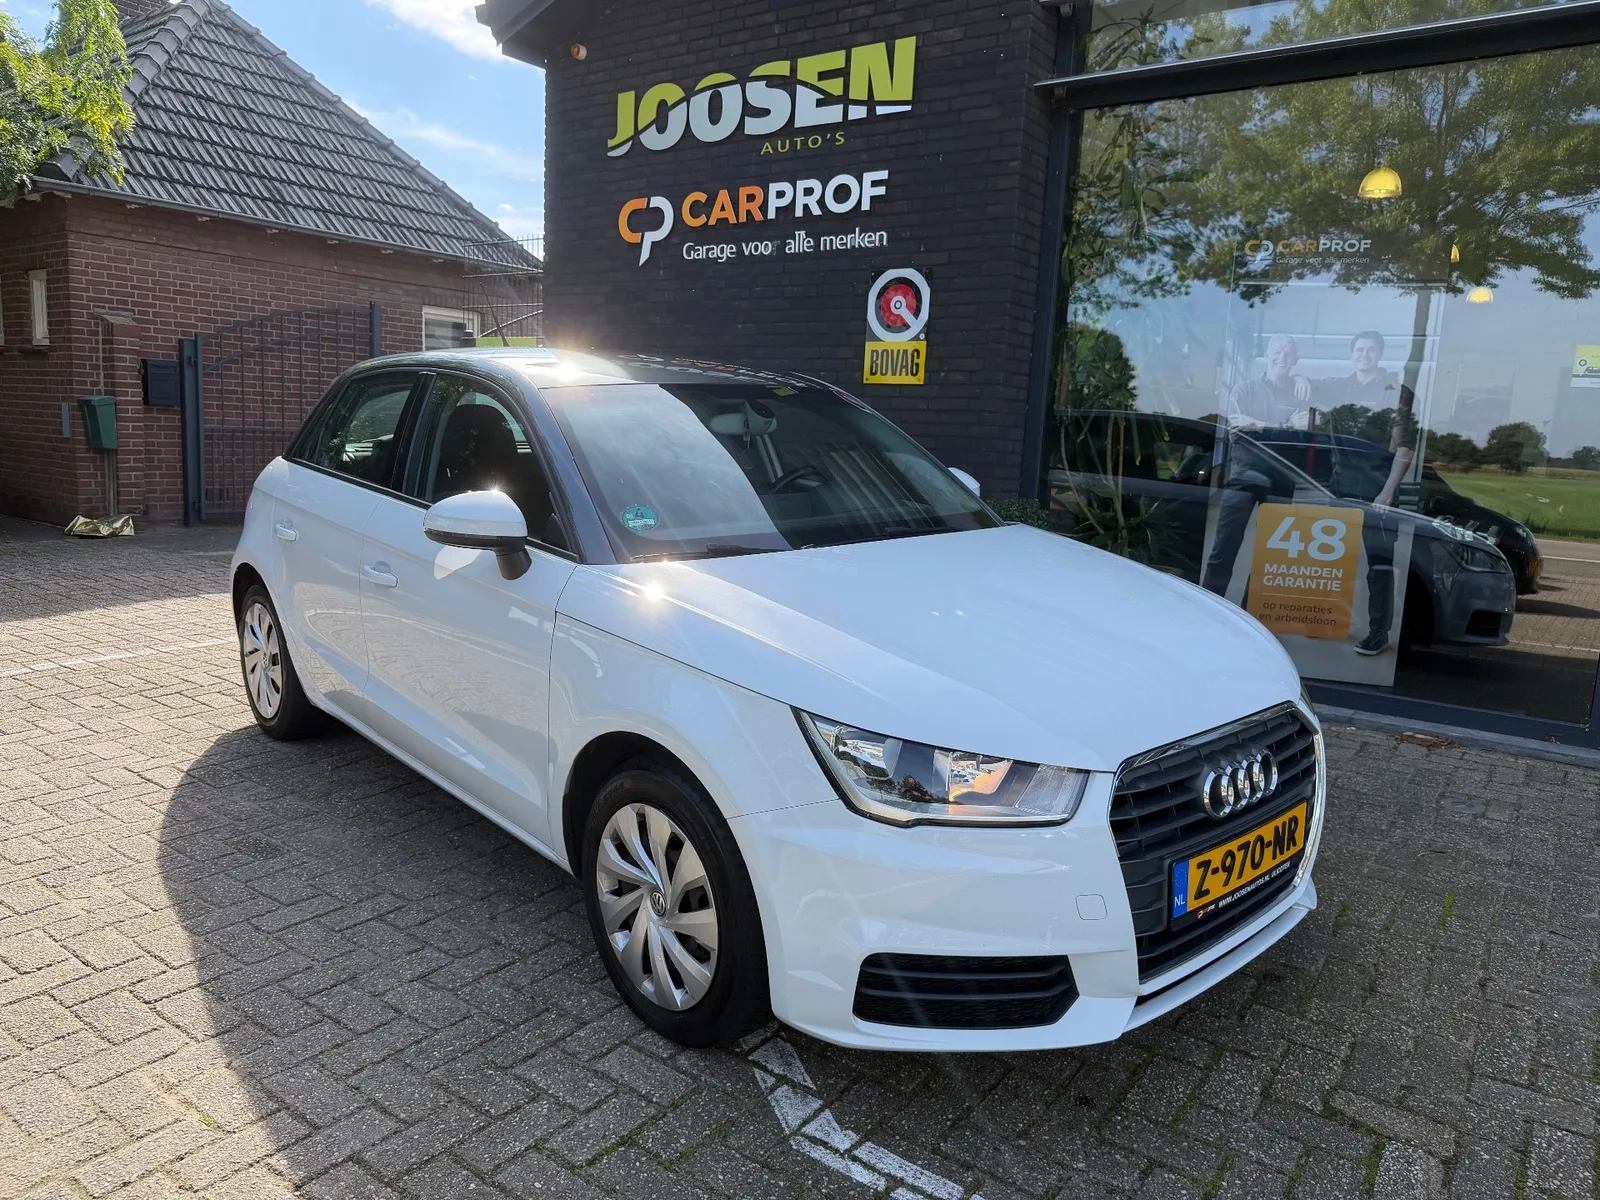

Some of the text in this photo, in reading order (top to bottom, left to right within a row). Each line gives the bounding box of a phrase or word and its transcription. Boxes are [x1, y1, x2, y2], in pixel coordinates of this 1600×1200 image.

[607, 36, 916, 157] JOOSEN
[760, 132, 845, 155] AUTO'S
[681, 170, 889, 227] CARPROF
[682, 243, 736, 262] Garage
[820, 227, 888, 251] merken
[1276, 240, 1372, 252] CARPROF
[1276, 256, 1303, 264] Garage
[869, 348, 921, 377] BOVAG
[1266, 516, 1347, 561] 48
[1264, 563, 1343, 578] MAANDEN
[1263, 575, 1342, 591] GARANTIE
[1263, 602, 1333, 614] op reparaties
[1258, 612, 1337, 626] en arbeidsloon
[1193, 815, 1299, 901] Z-970-NR
[1174, 893, 1186, 908] NL
